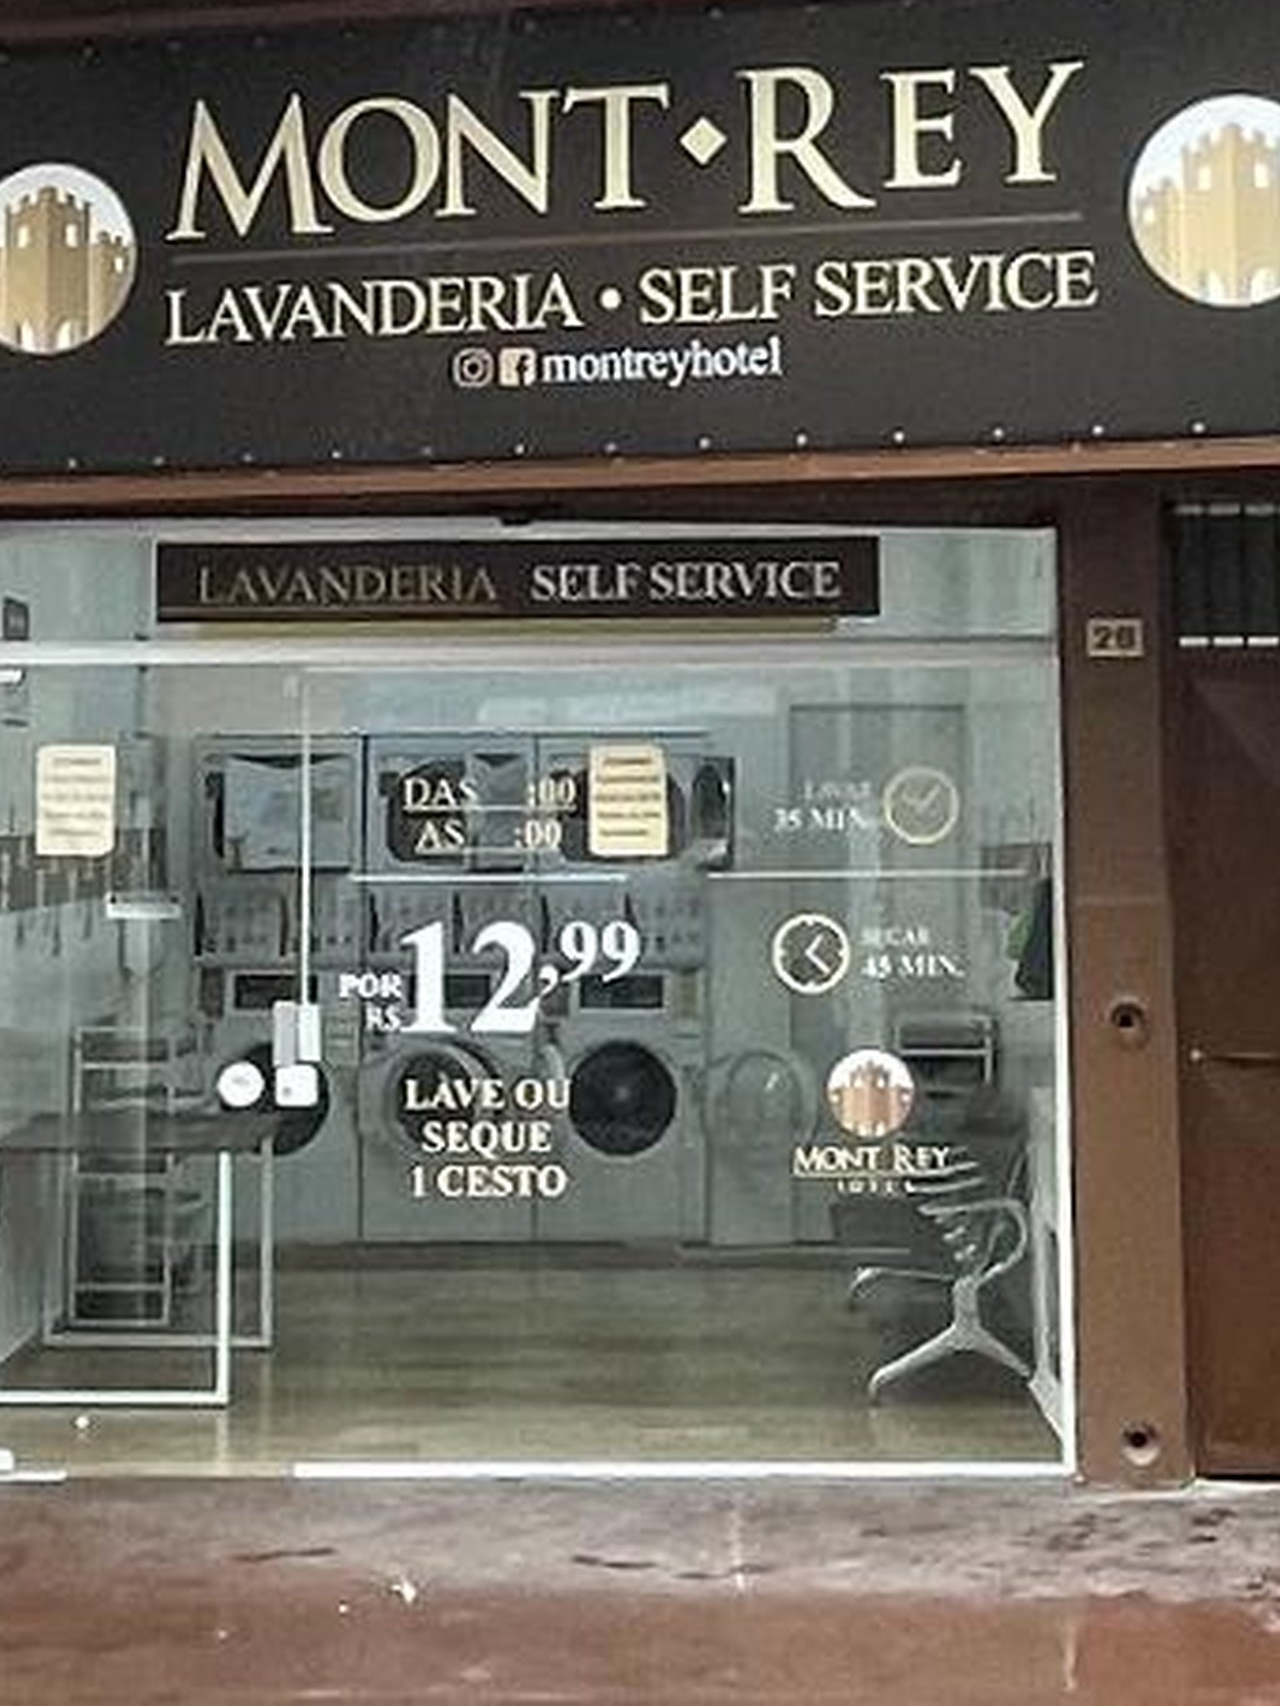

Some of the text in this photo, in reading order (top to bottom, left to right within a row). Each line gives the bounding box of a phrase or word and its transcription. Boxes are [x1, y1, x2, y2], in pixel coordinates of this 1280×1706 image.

[165, 61, 1084, 240] MONT REY
[164, 250, 1099, 346] LAVANDERIA SELF SERVICE
[541, 335, 783, 388] montreyhotel
[199, 560, 841, 604] LAVANDERIA SELF SERVICE
[403, 776, 480, 808] DAS
[339, 973, 402, 998] POR
[403, 1077, 571, 1110] LAVE OU
[421, 1120, 553, 1160] SEQUE
[792, 1143, 951, 1174] MONT REY
[411, 1165, 569, 1198] 1 CESTO
